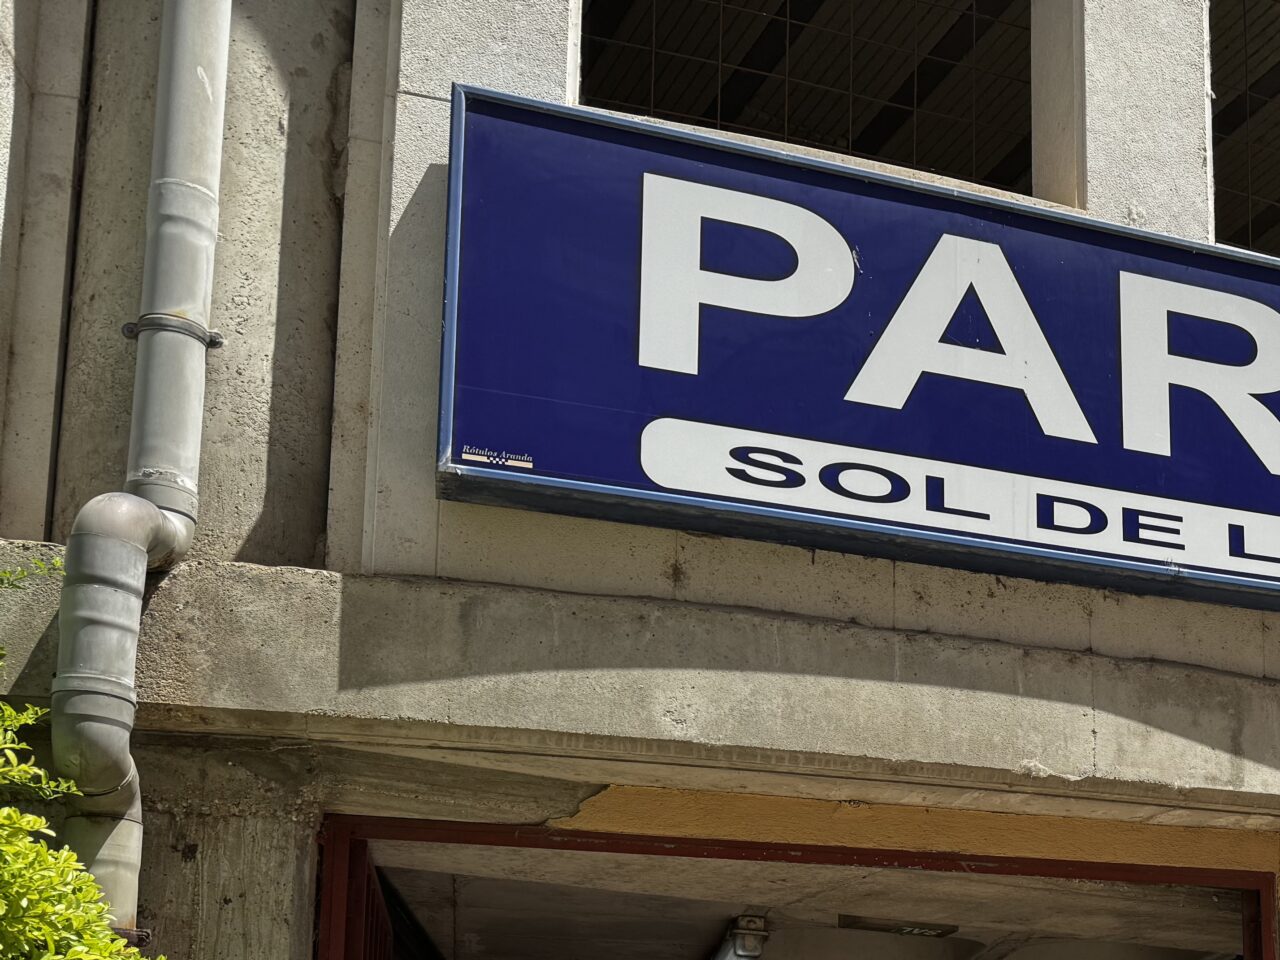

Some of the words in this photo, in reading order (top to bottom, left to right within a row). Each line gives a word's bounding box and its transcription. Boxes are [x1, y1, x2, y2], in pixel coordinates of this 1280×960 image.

[462, 444, 498, 457] Rótulos
[499, 450, 533, 462] Aranda
[725, 445, 990, 521] SOL
[1036, 493, 1186, 551] DE
